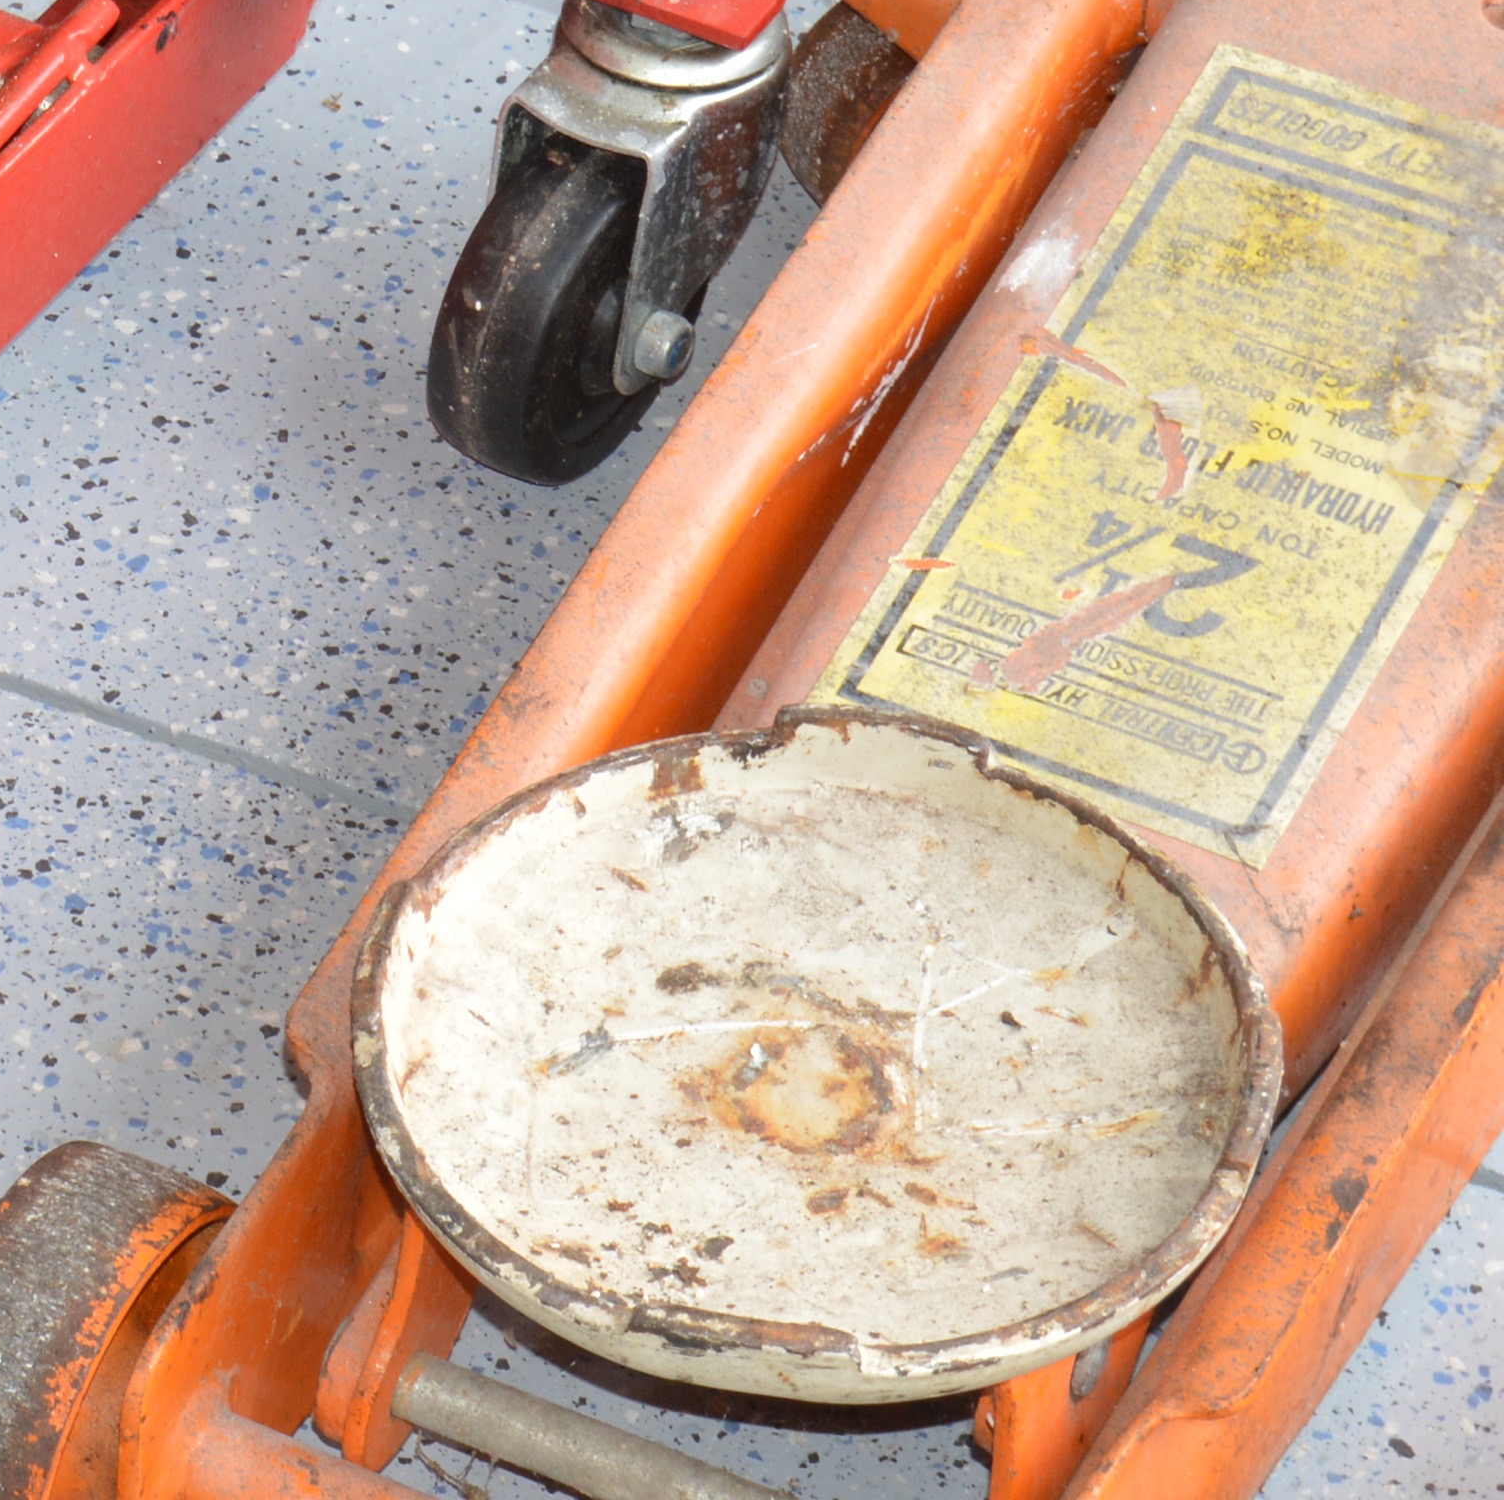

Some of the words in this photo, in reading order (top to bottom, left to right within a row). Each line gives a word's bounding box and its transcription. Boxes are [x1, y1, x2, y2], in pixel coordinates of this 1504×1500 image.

[1227, 92, 1369, 156] GOGGLES
[1229, 340, 1343, 388] CAUTION
[1049, 395, 1139, 447] JACK
[1304, 438, 1386, 475] MODEL
[1087, 467, 1243, 532] CAPACITY
[1253, 522, 1323, 560] TON
[939, 590, 1039, 641] QUALITY
[1094, 697, 1215, 755] CENTRAL
[1218, 688, 1272, 723] THE
